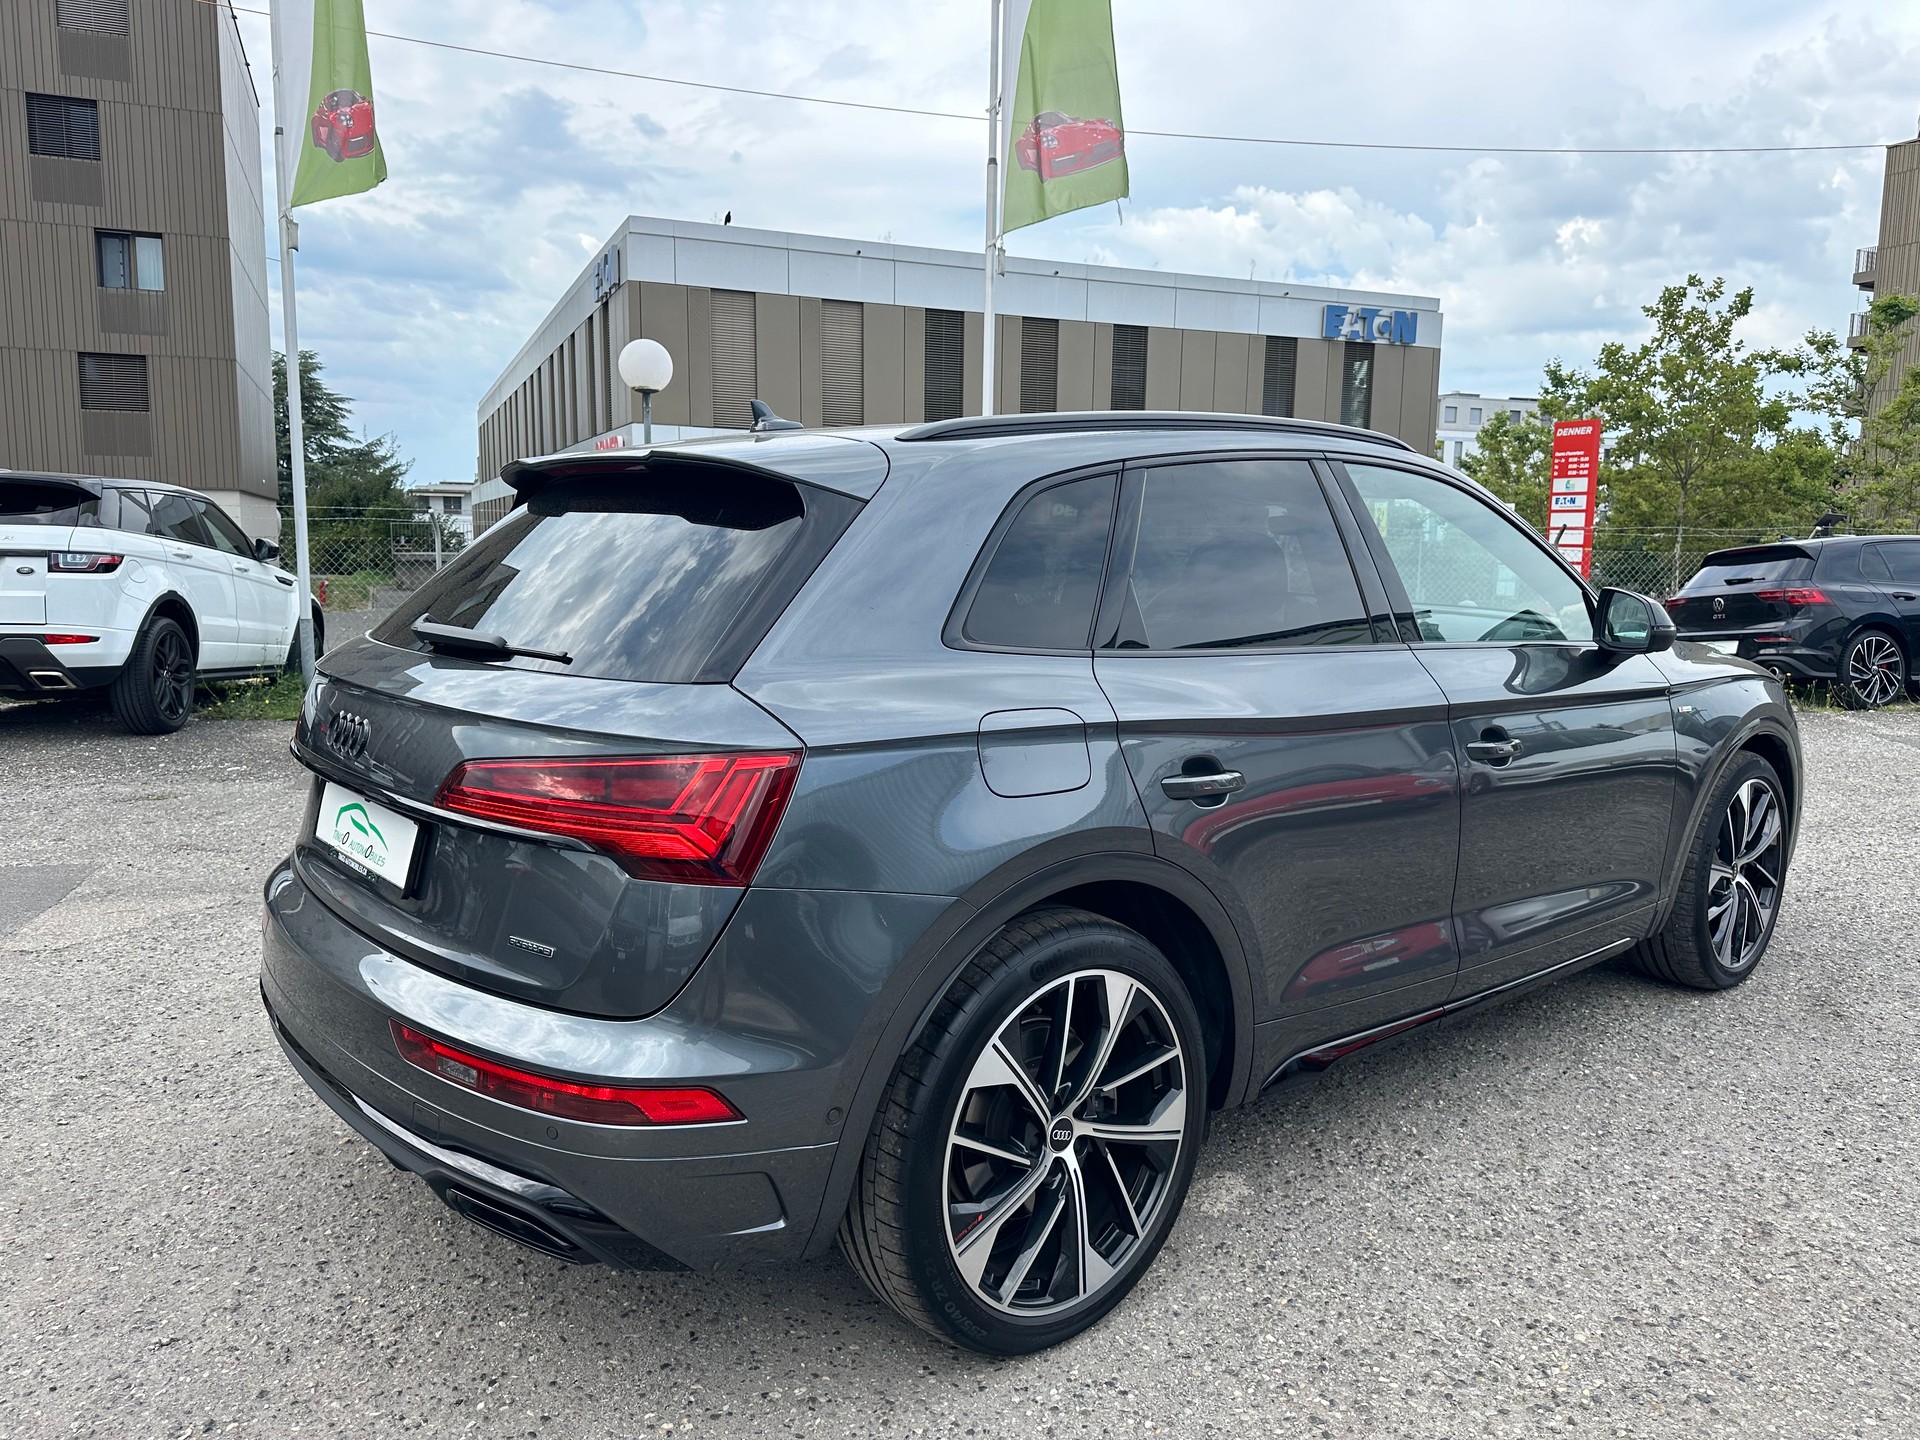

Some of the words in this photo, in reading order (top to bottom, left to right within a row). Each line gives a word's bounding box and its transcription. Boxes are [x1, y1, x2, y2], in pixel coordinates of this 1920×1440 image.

[1322, 304, 1418, 344] EATON
[1556, 426, 1593, 437] DENNER
[1555, 497, 1576, 505] EATON
[1712, 613, 1726, 621] GTI
[348, 840, 386, 868] AUTOMOBILES
[509, 938, 551, 955] quattro
